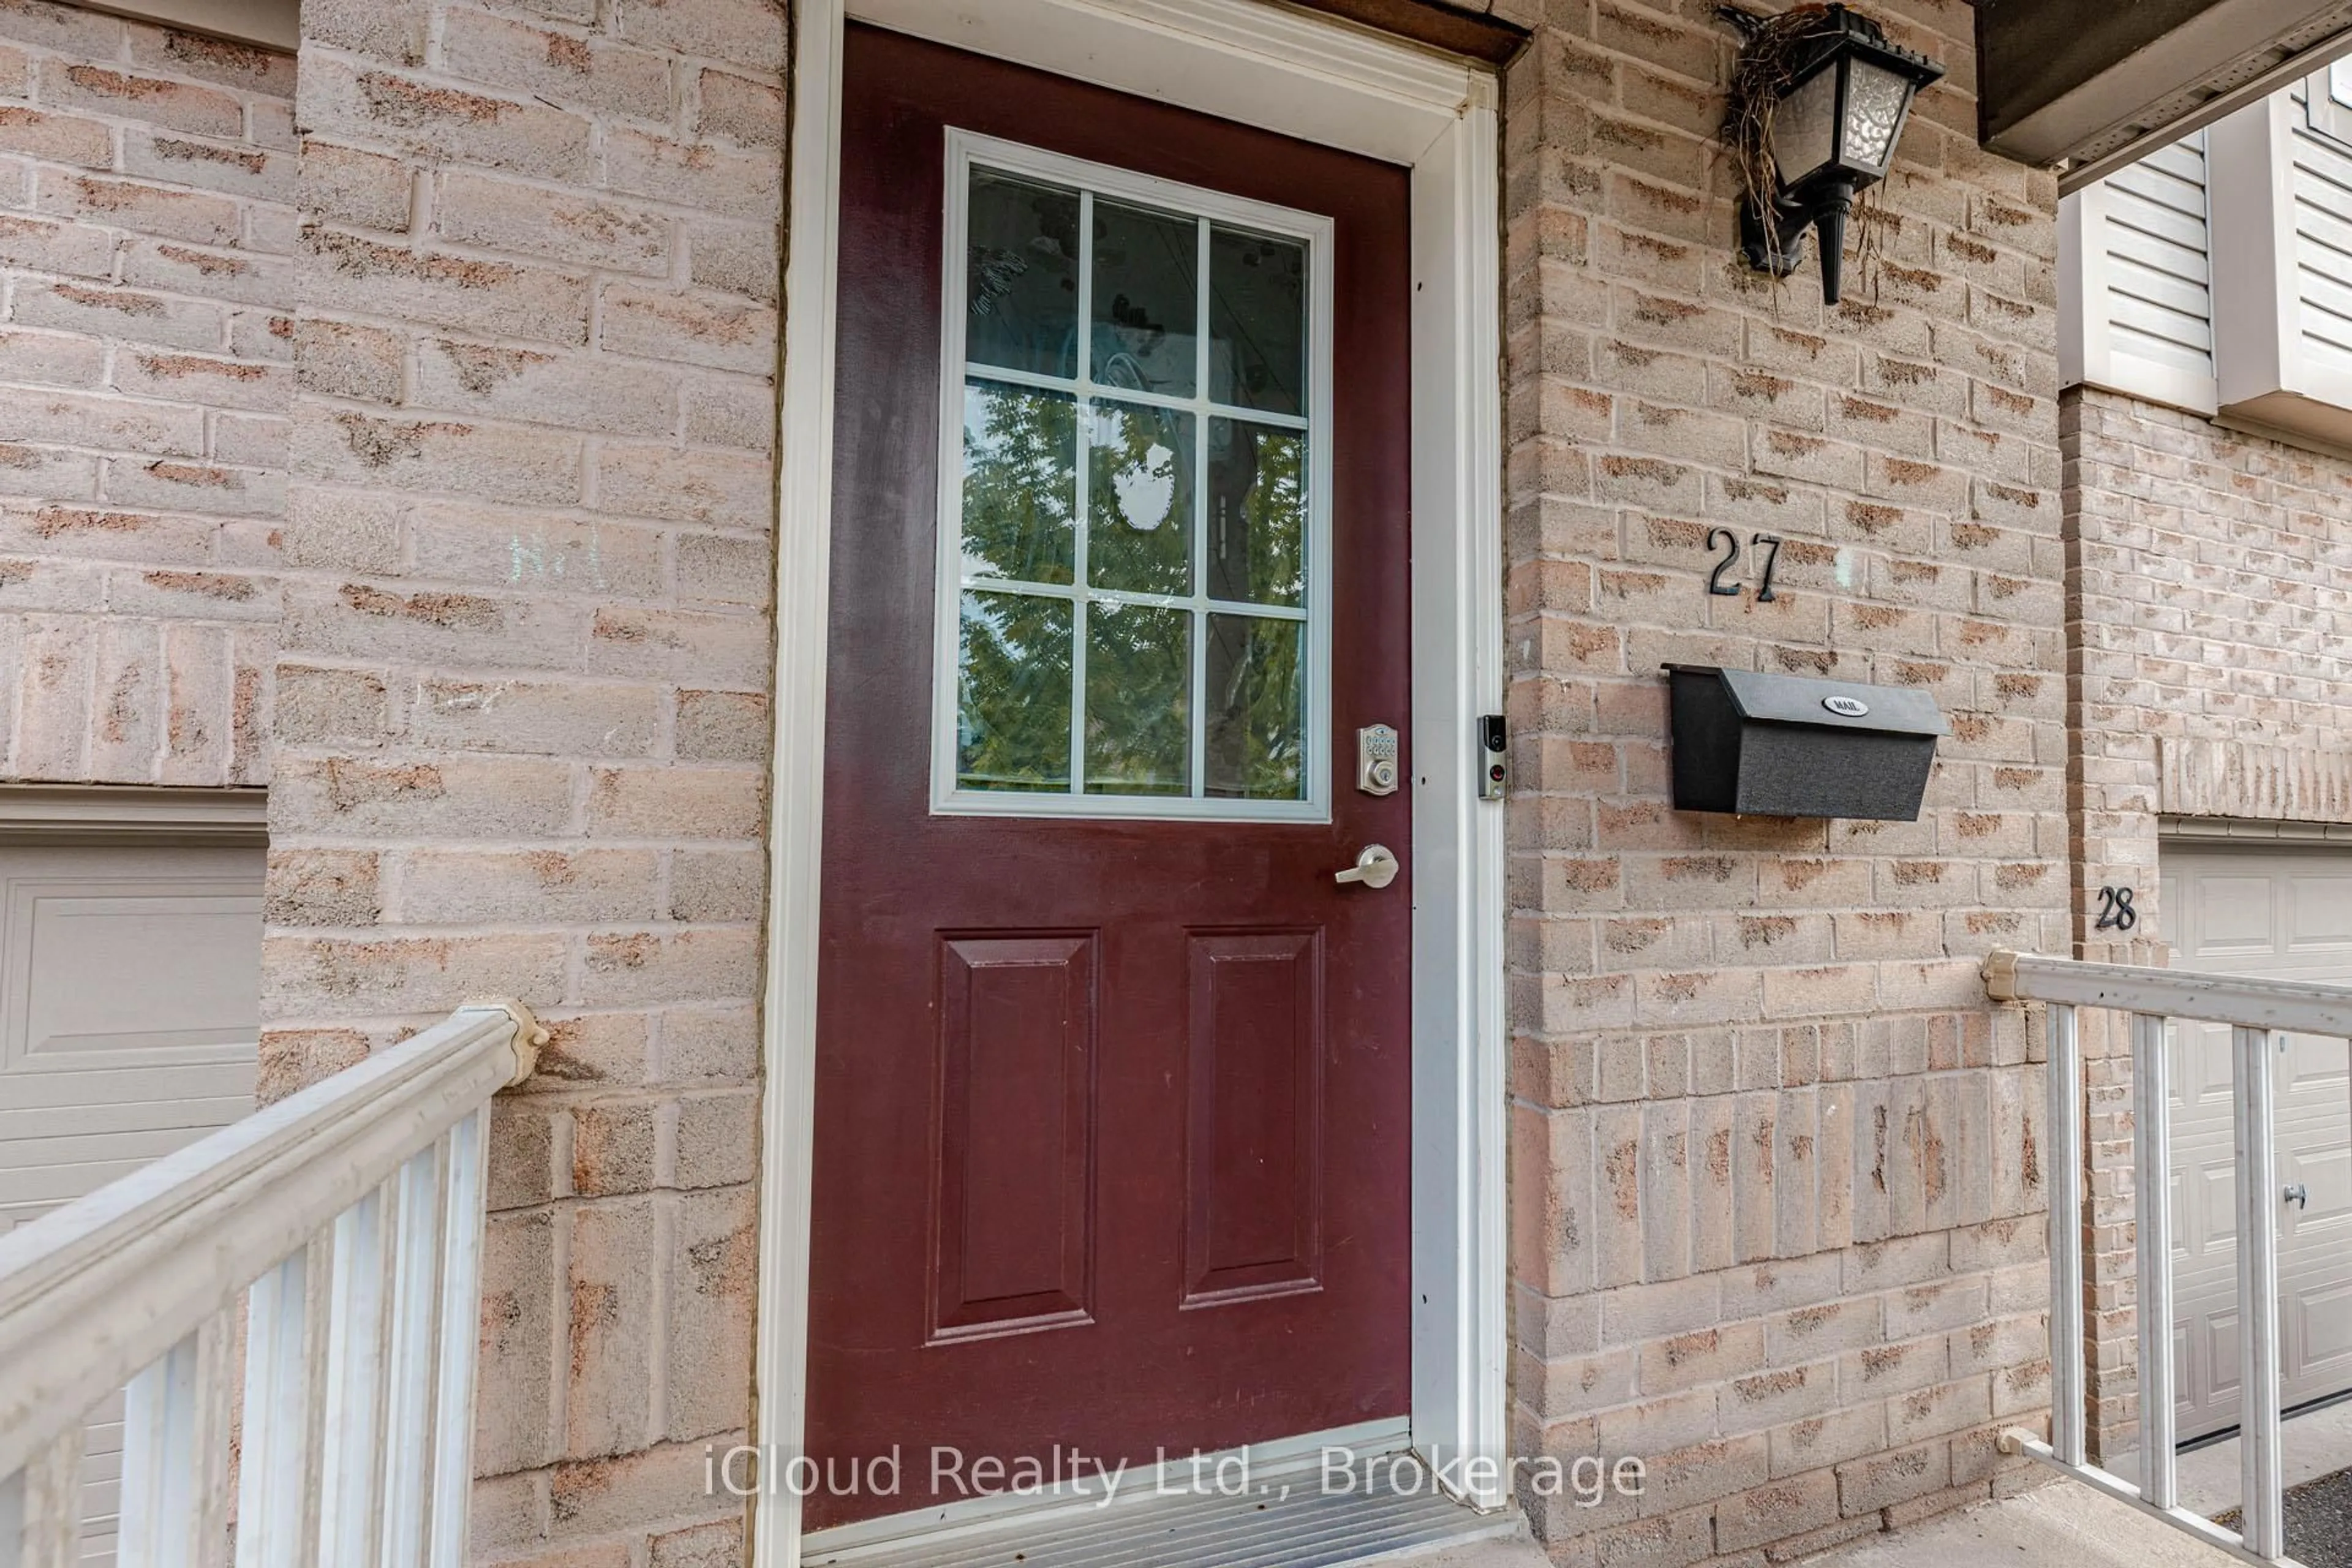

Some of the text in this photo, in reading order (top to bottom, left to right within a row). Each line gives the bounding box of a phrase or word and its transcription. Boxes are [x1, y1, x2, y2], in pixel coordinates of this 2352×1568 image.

[1707, 527, 1782, 602] 27
[1834, 699, 1860, 711] MAIL
[2094, 886, 2136, 930] 28
